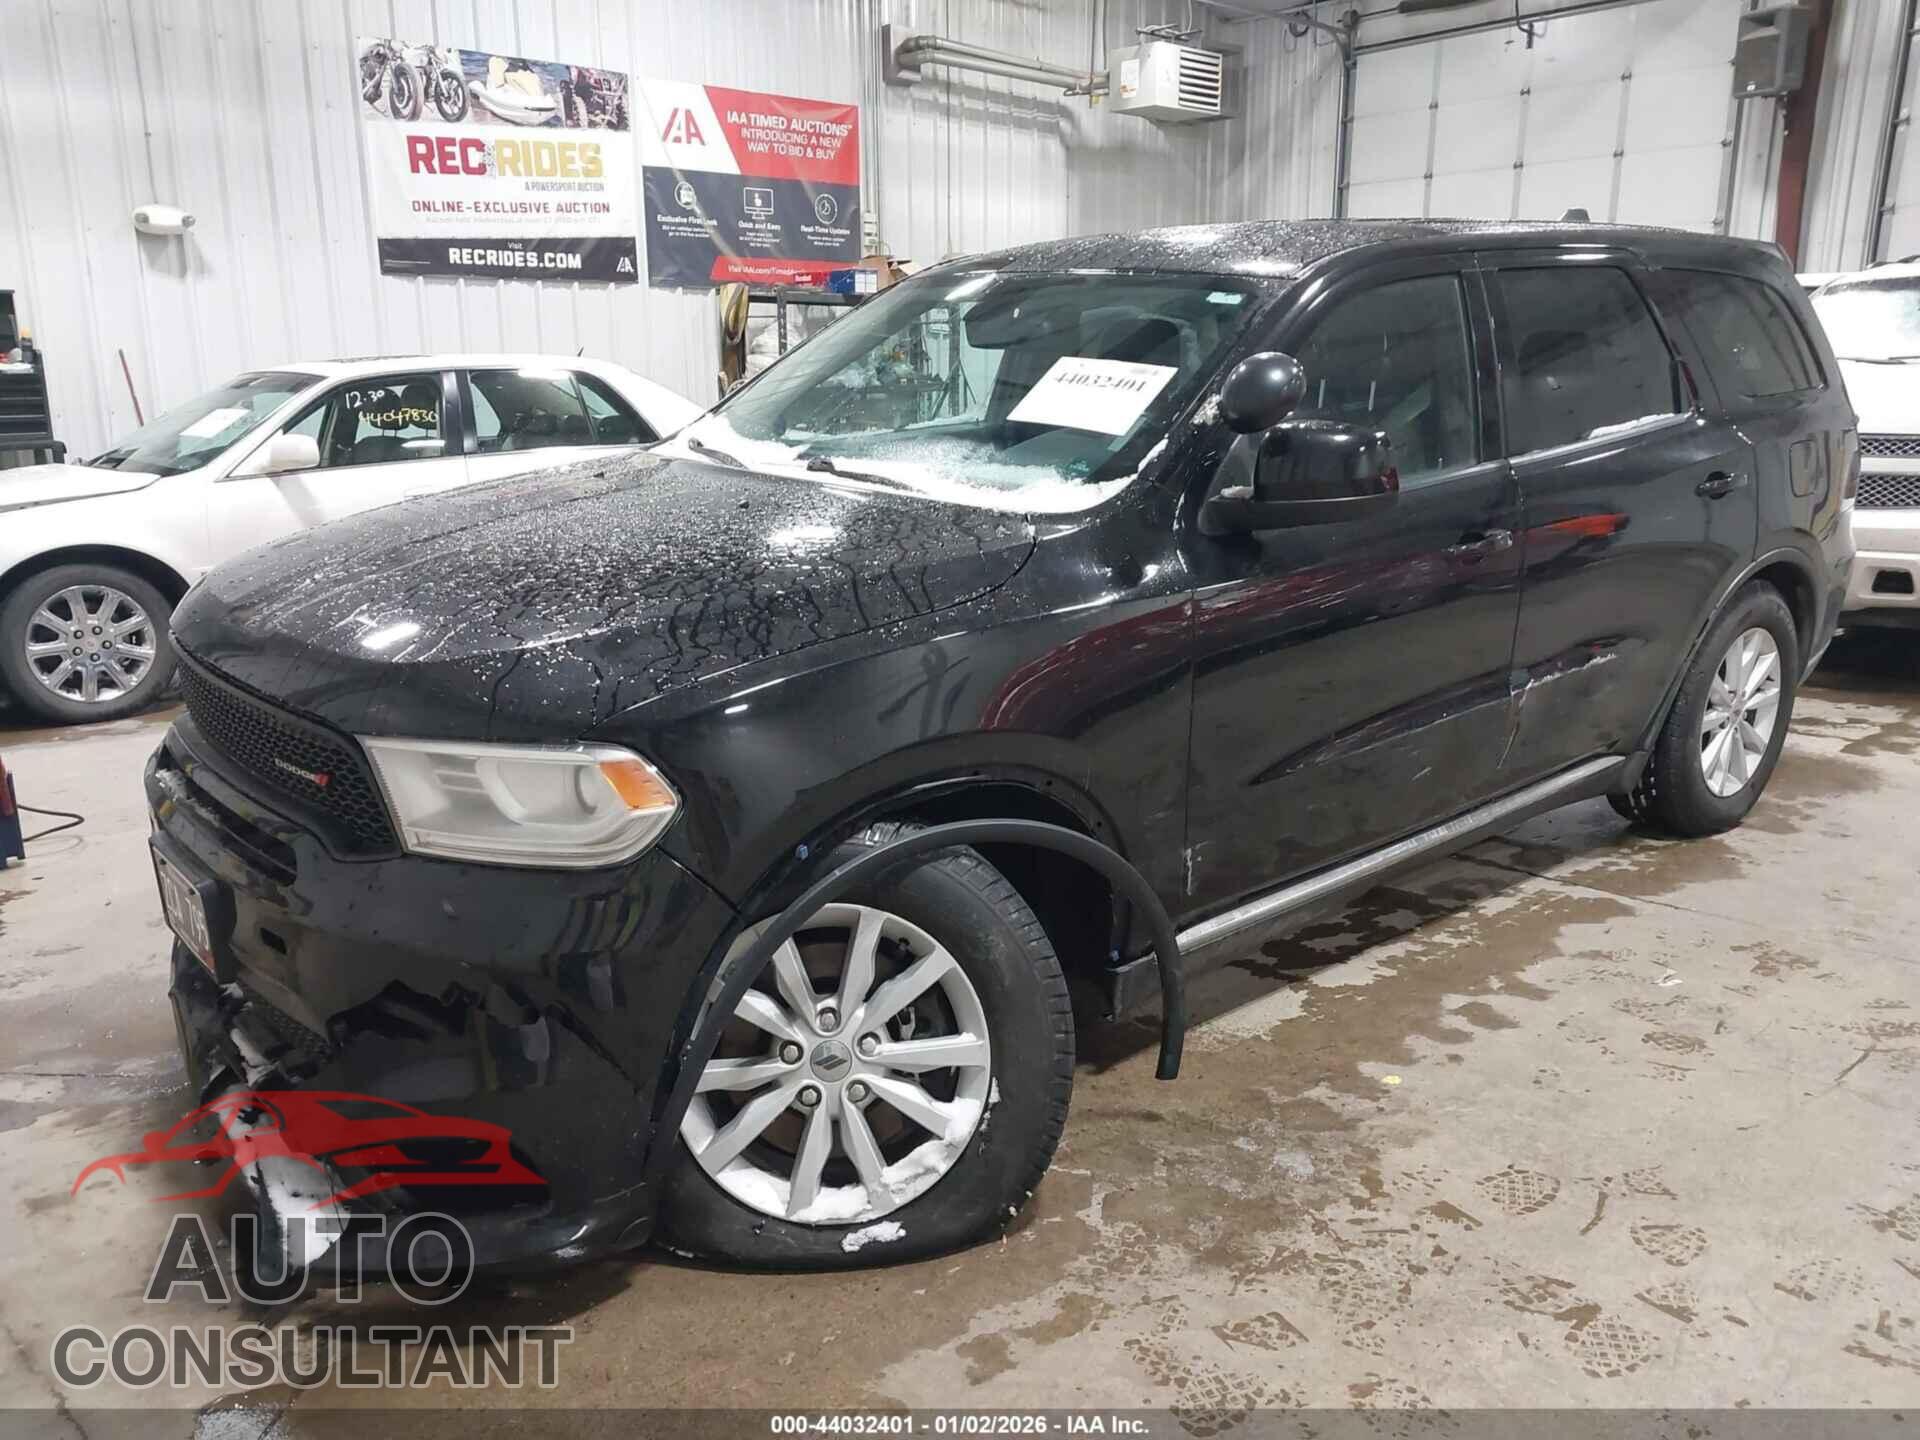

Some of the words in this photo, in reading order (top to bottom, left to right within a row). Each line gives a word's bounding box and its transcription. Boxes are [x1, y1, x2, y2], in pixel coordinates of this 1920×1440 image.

[727, 110, 748, 125] IAA
[749, 112, 787, 129] TIMED
[741, 128, 808, 145] INTRODUCING
[810, 136, 818, 146] A
[820, 137, 842, 148] NEW
[406, 135, 488, 176] REC
[495, 139, 603, 178] RIDES
[747, 141, 770, 153] WAY
[773, 143, 787, 155] TO
[788, 145, 804, 157] BID
[806, 148, 814, 158] &
[816, 149, 836, 160] BUY
[411, 200, 551, 214] ONLINE-EXCLUSIVE
[556, 201, 611, 214] AUCTION
[507, 242, 522, 250] Visit
[448, 247, 582, 269] RECRIDES.COM
[1055, 372, 1147, 392] 44032401
